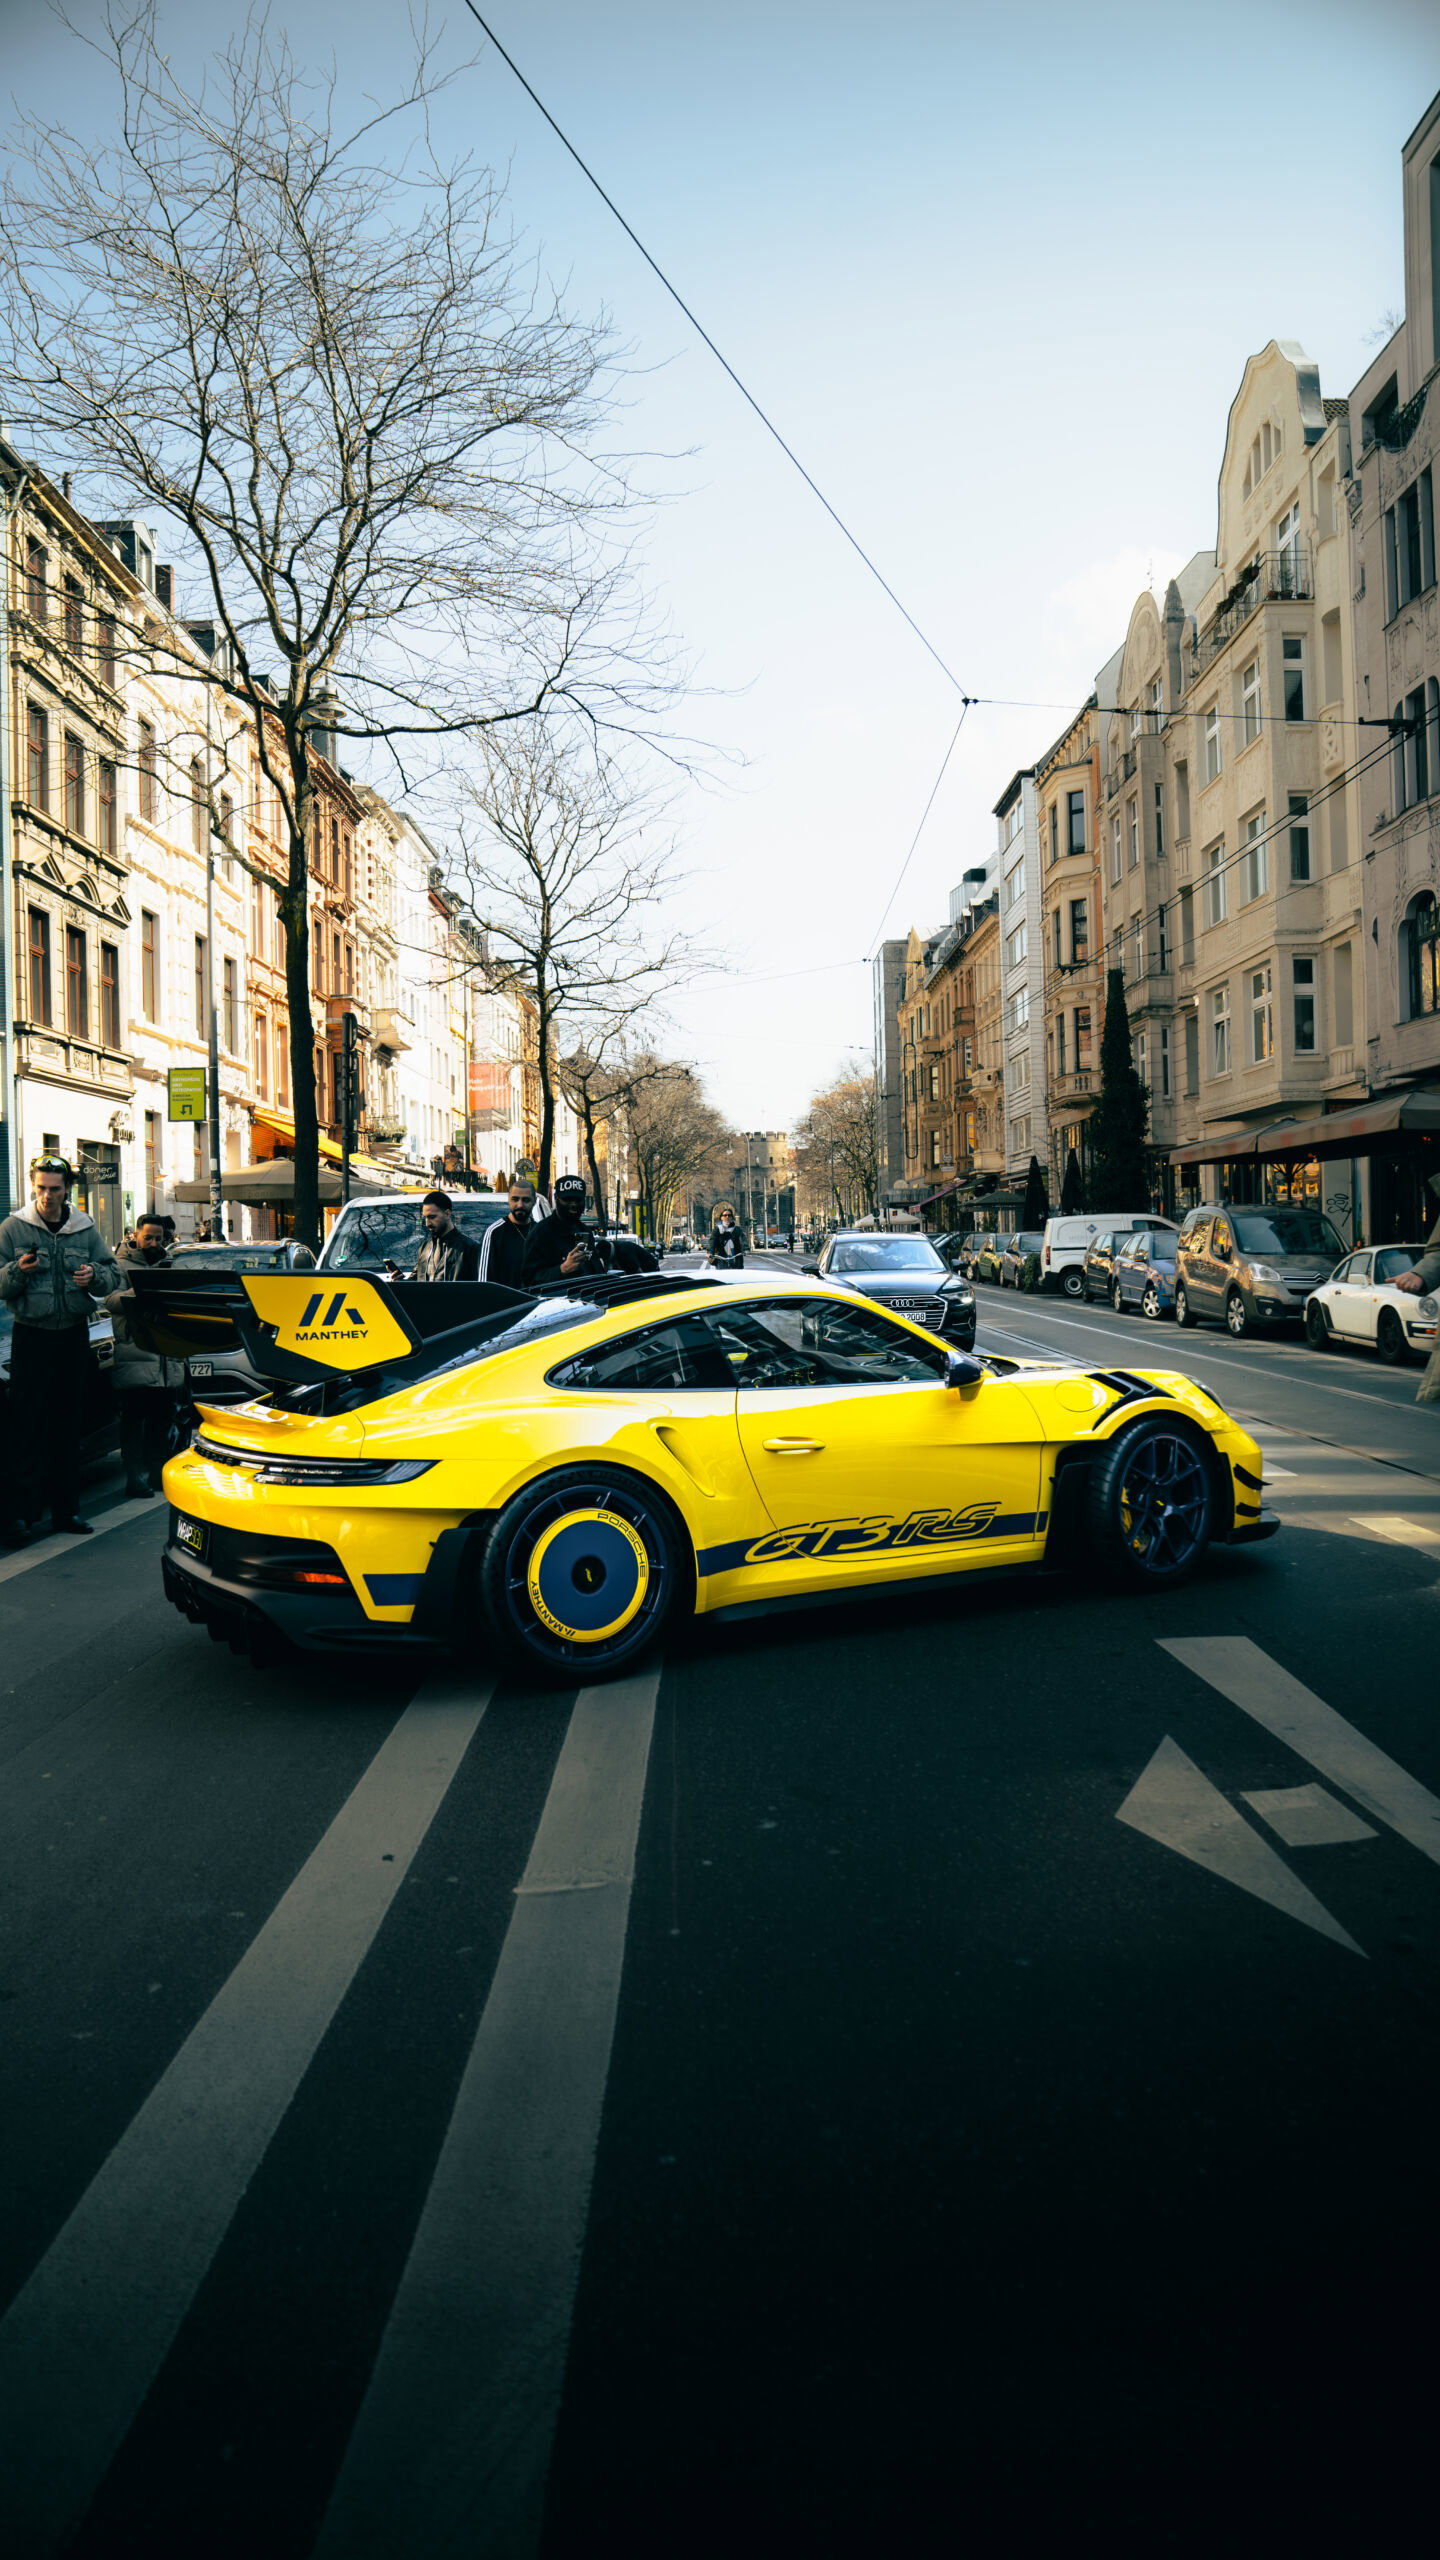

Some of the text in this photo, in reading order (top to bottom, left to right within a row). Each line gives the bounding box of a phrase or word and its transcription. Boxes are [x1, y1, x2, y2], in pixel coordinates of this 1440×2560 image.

[559, 1180, 584, 1192] LORE
[906, 1313, 925, 1321] 2008
[295, 1329, 369, 1341] MANTHEY
[190, 1364, 211, 1375] 727
[597, 1512, 646, 1578] PORSCHE
[530, 1580, 564, 1632] MANTHEY
